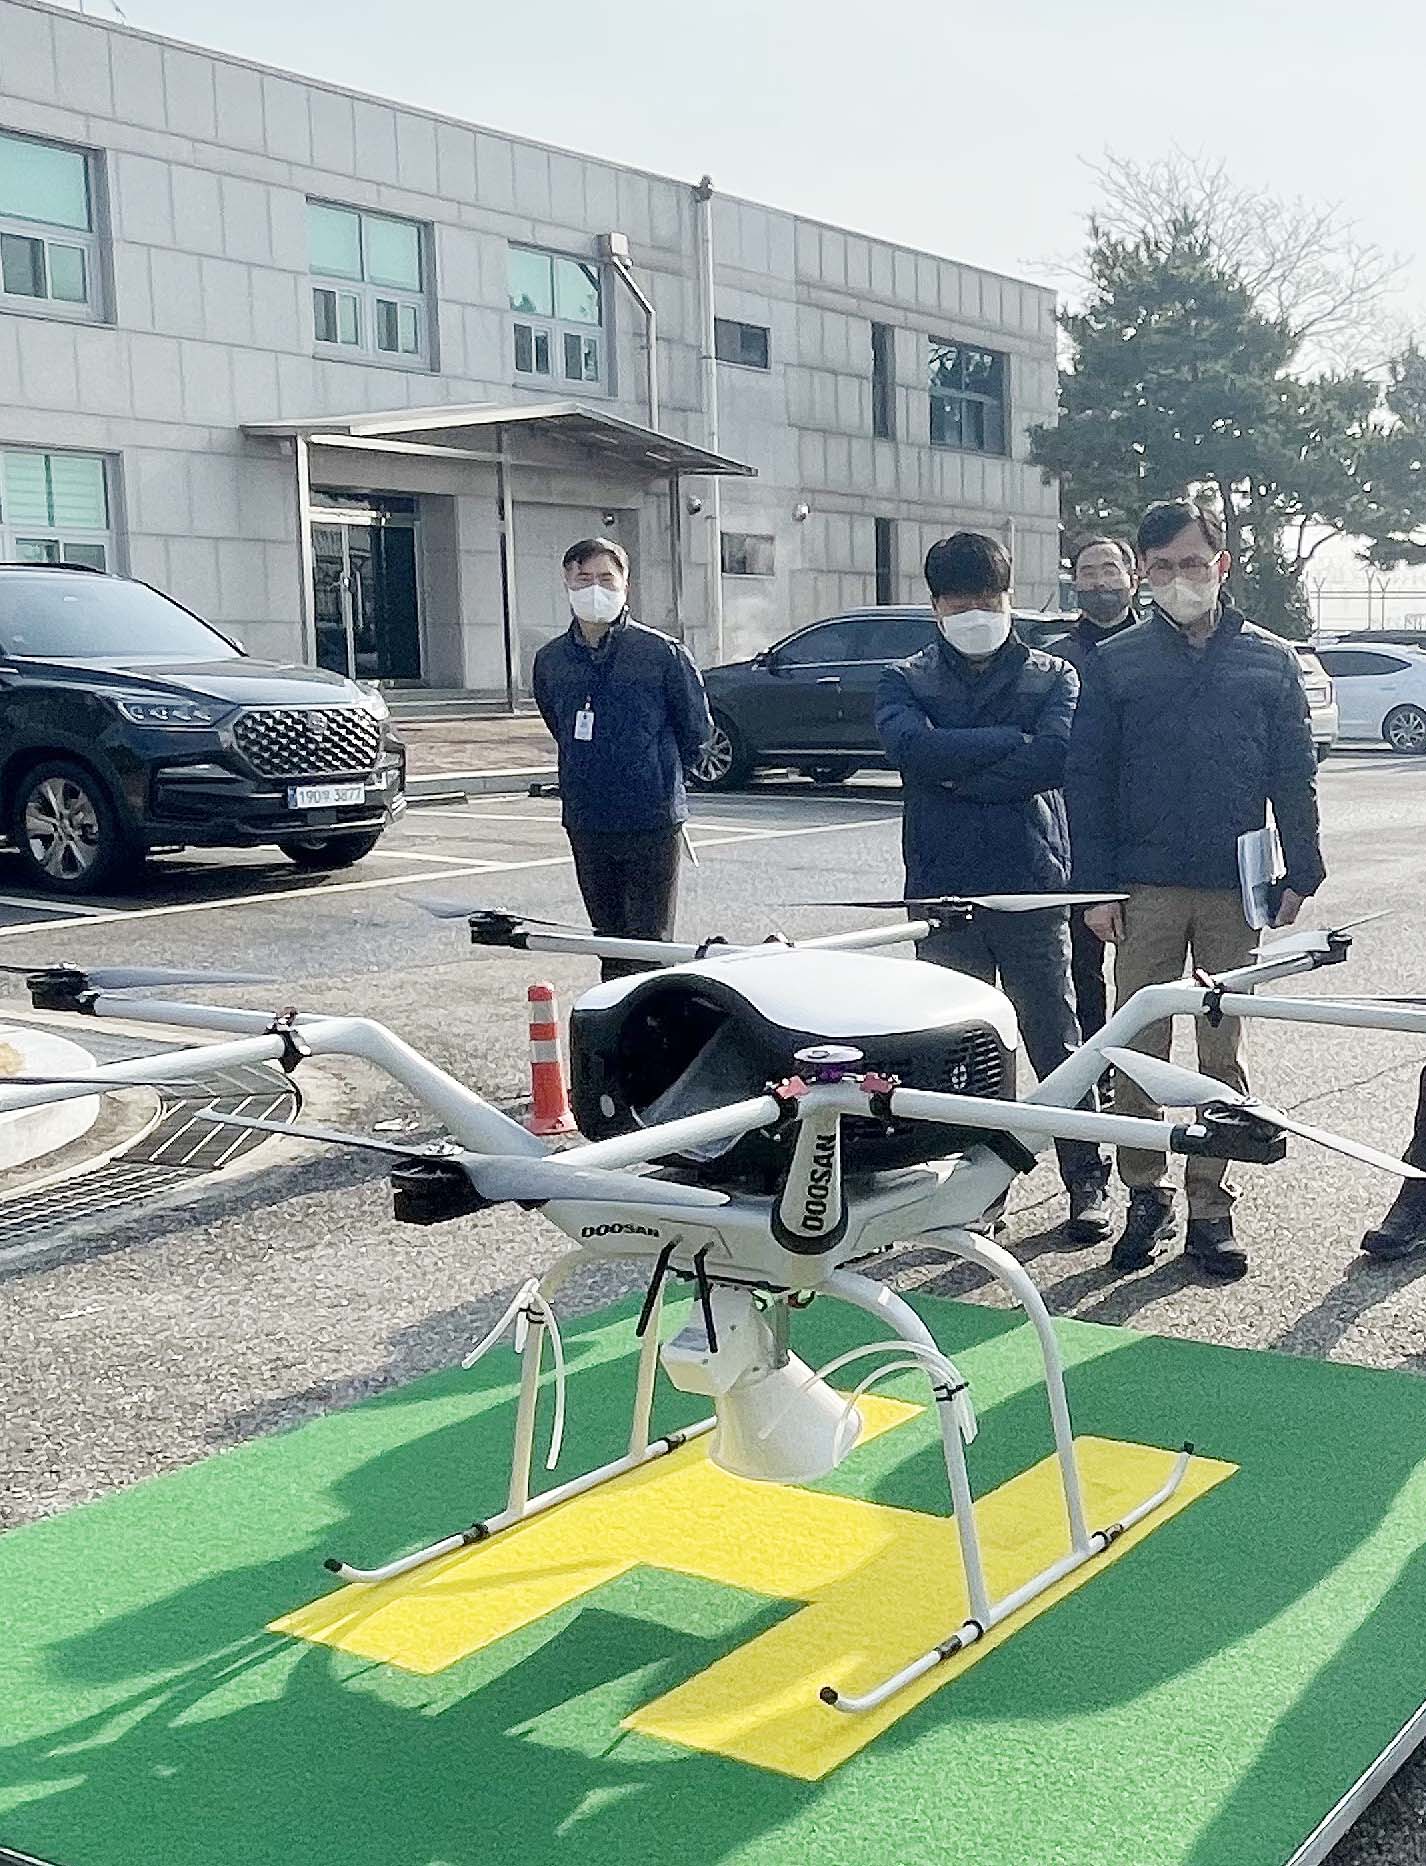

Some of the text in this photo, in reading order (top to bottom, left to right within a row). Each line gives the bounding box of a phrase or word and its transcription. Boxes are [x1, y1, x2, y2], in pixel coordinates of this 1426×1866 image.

[582, 1223, 659, 1238] DOOSAN
[802, 1133, 837, 1231] DOOSAN
[267, 1391, 1241, 1782] H
